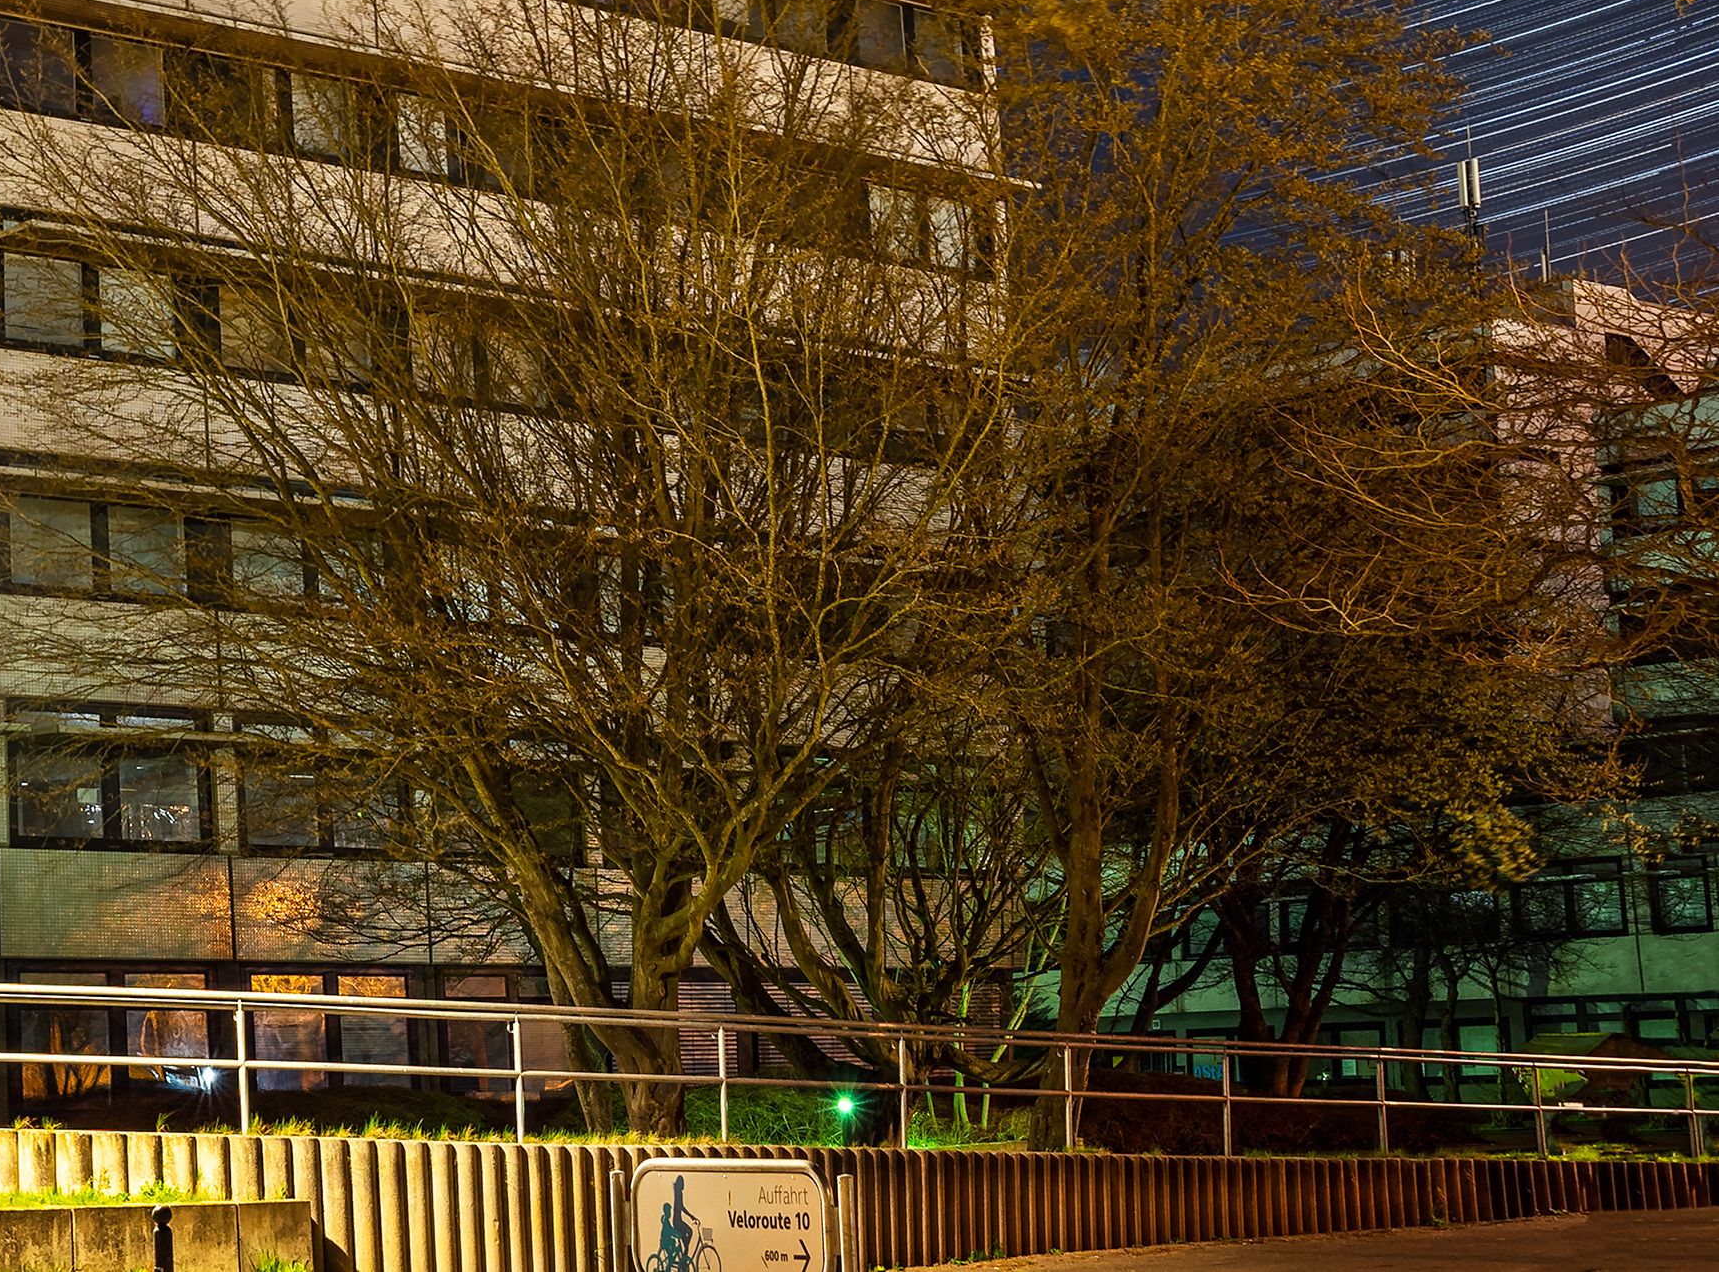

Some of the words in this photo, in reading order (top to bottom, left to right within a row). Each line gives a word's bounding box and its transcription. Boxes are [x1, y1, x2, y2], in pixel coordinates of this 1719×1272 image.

[758, 1185, 809, 1205] Auffahrt
[727, 1209, 792, 1230] Veloroute
[794, 1211, 811, 1231] 10
[764, 1249, 780, 1262] 600
[780, 1252, 789, 1262] m
